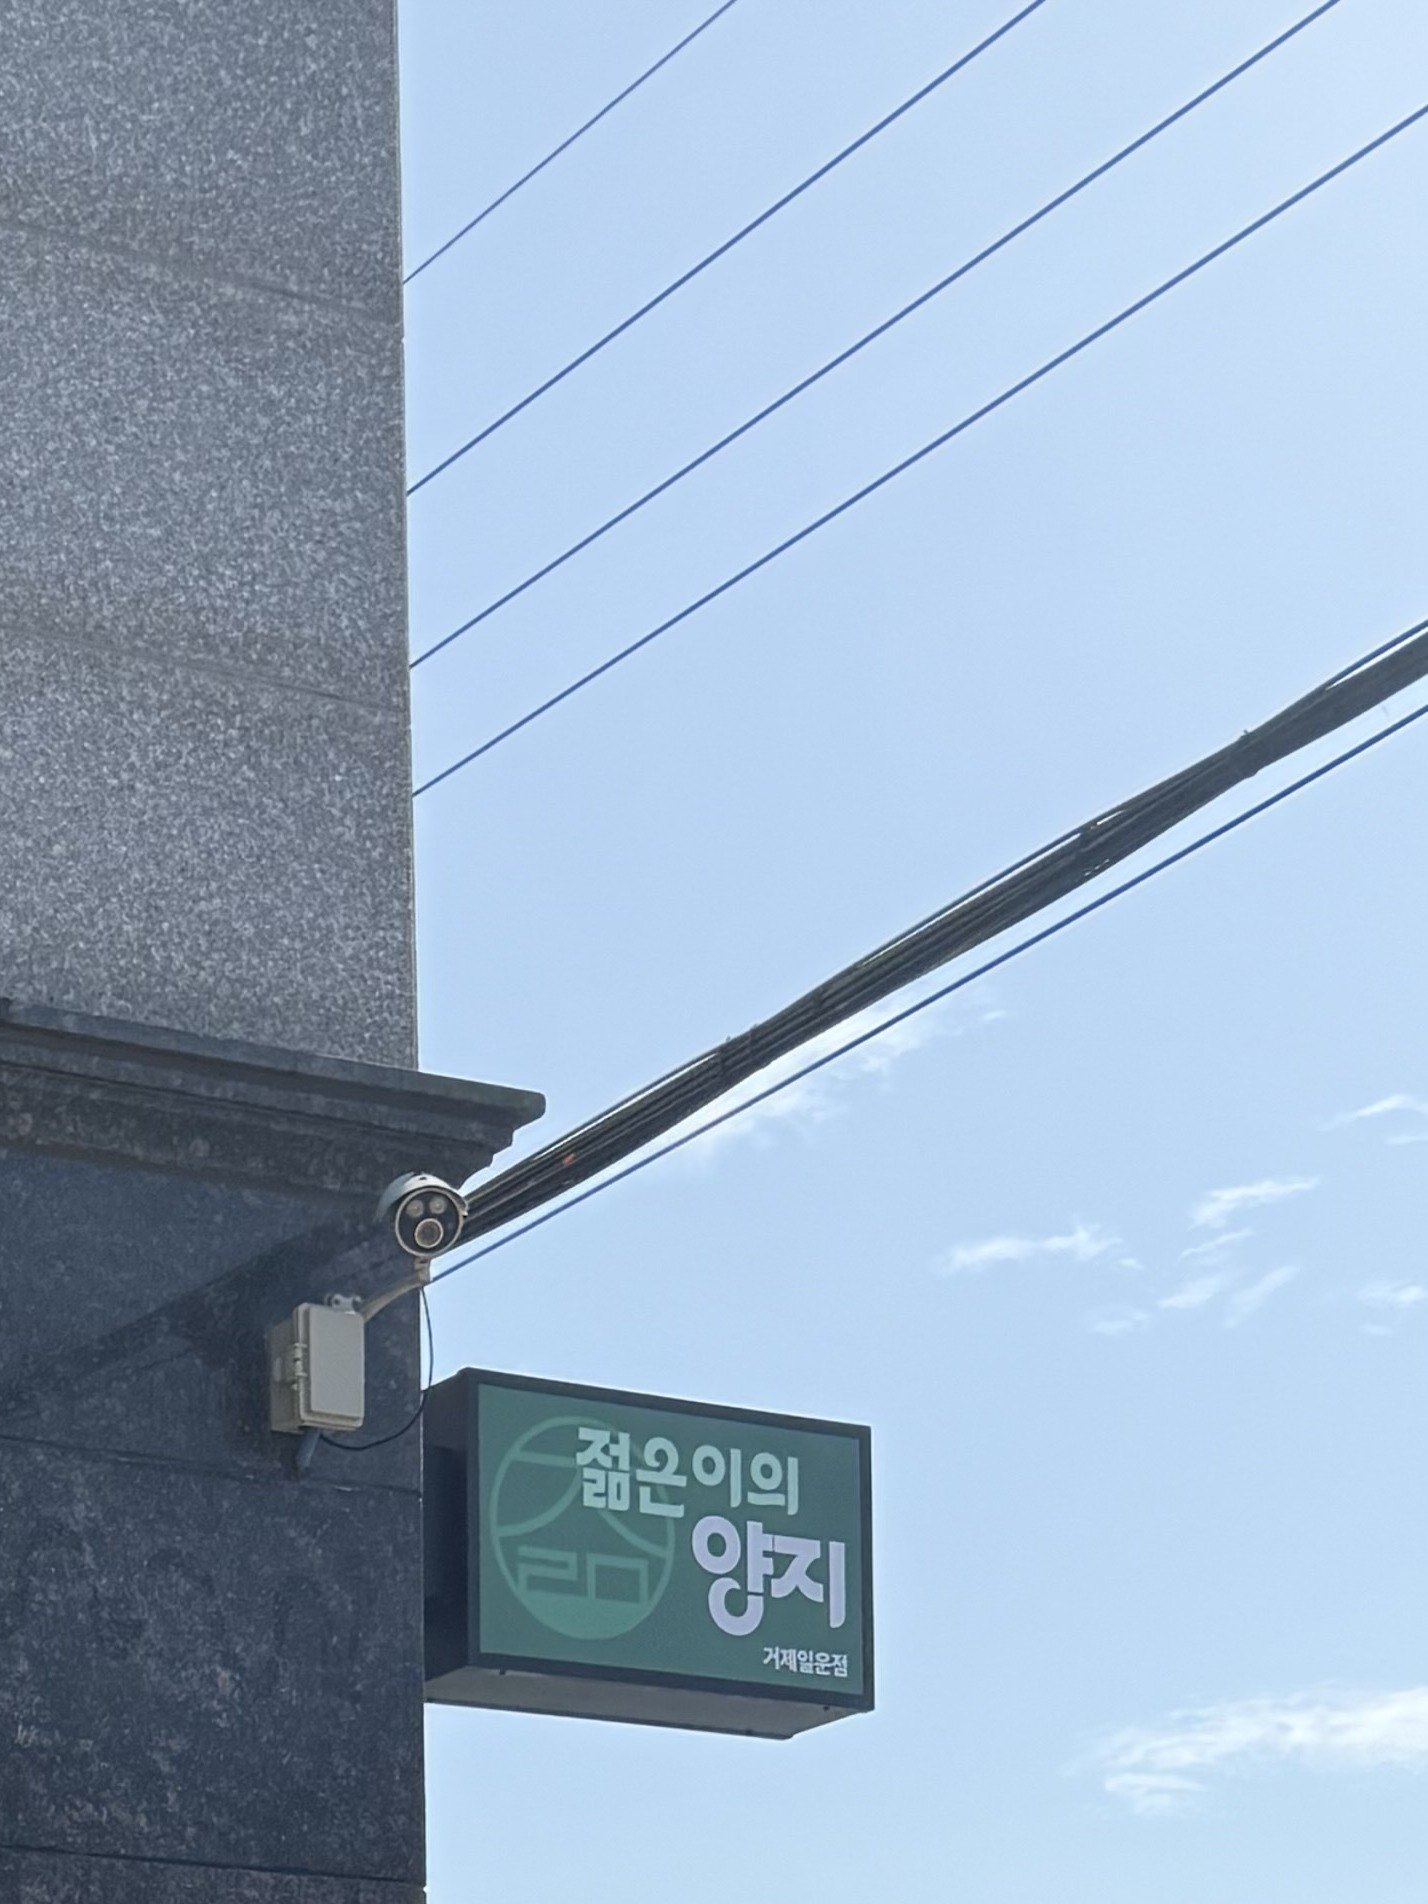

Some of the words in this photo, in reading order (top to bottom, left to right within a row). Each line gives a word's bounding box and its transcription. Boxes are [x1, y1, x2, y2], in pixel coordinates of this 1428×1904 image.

[575, 1425, 798, 1519] 젊은이의
[691, 1515, 846, 1636] 양지
[762, 1646, 849, 1677] 거제일운점
